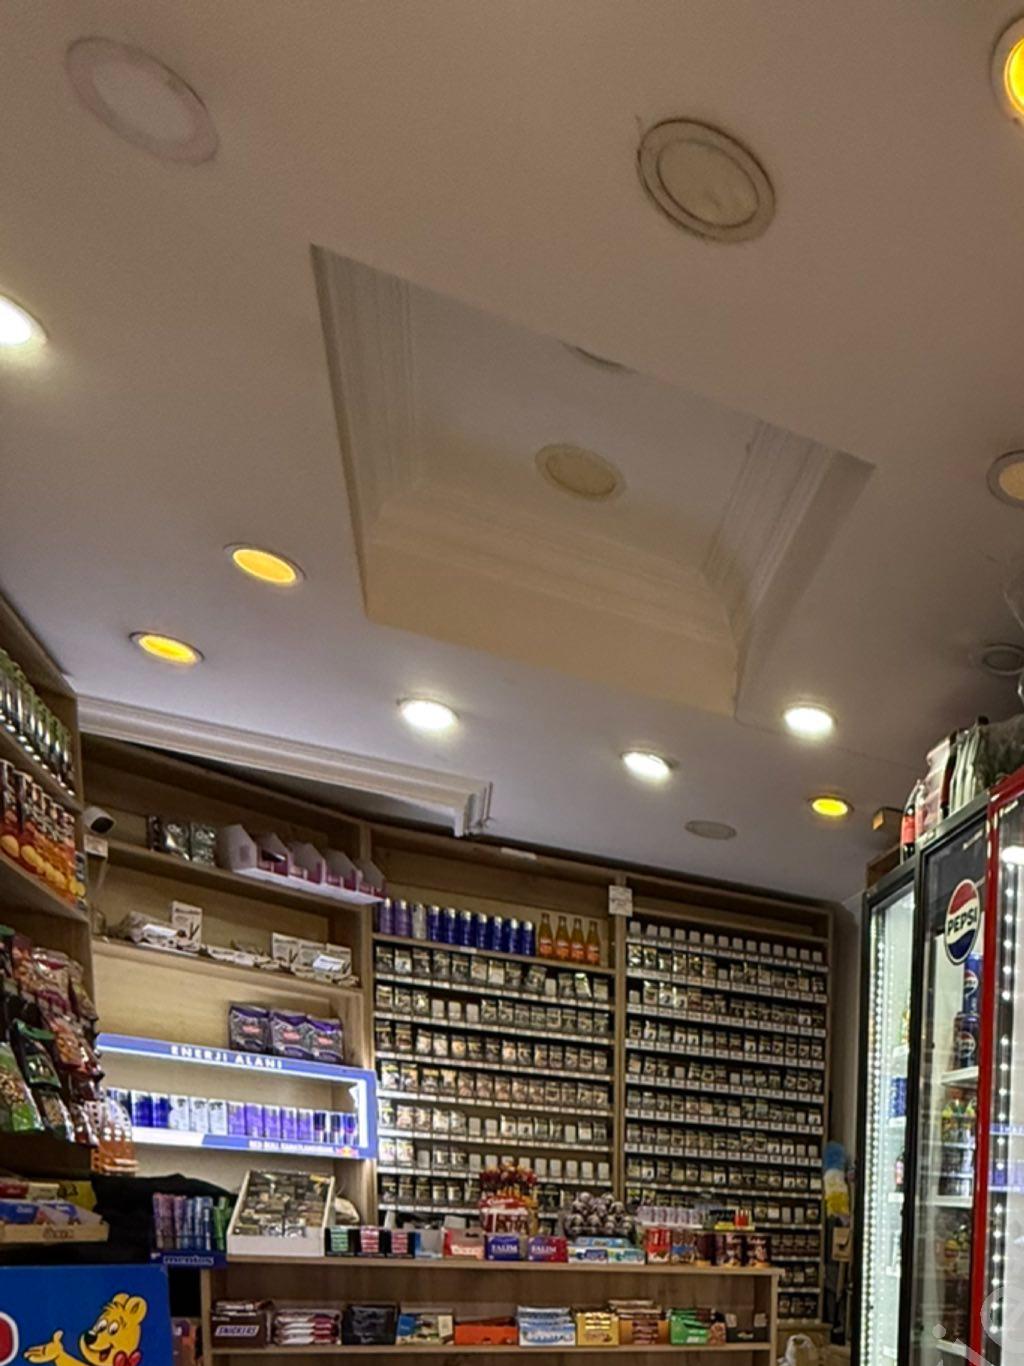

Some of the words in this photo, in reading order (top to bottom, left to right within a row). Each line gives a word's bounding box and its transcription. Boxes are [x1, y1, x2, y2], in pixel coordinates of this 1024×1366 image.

[947, 906, 978, 934] PEPSI
[163, 1254, 215, 1266] mentos
[217, 1326, 258, 1337] SNICKERS
